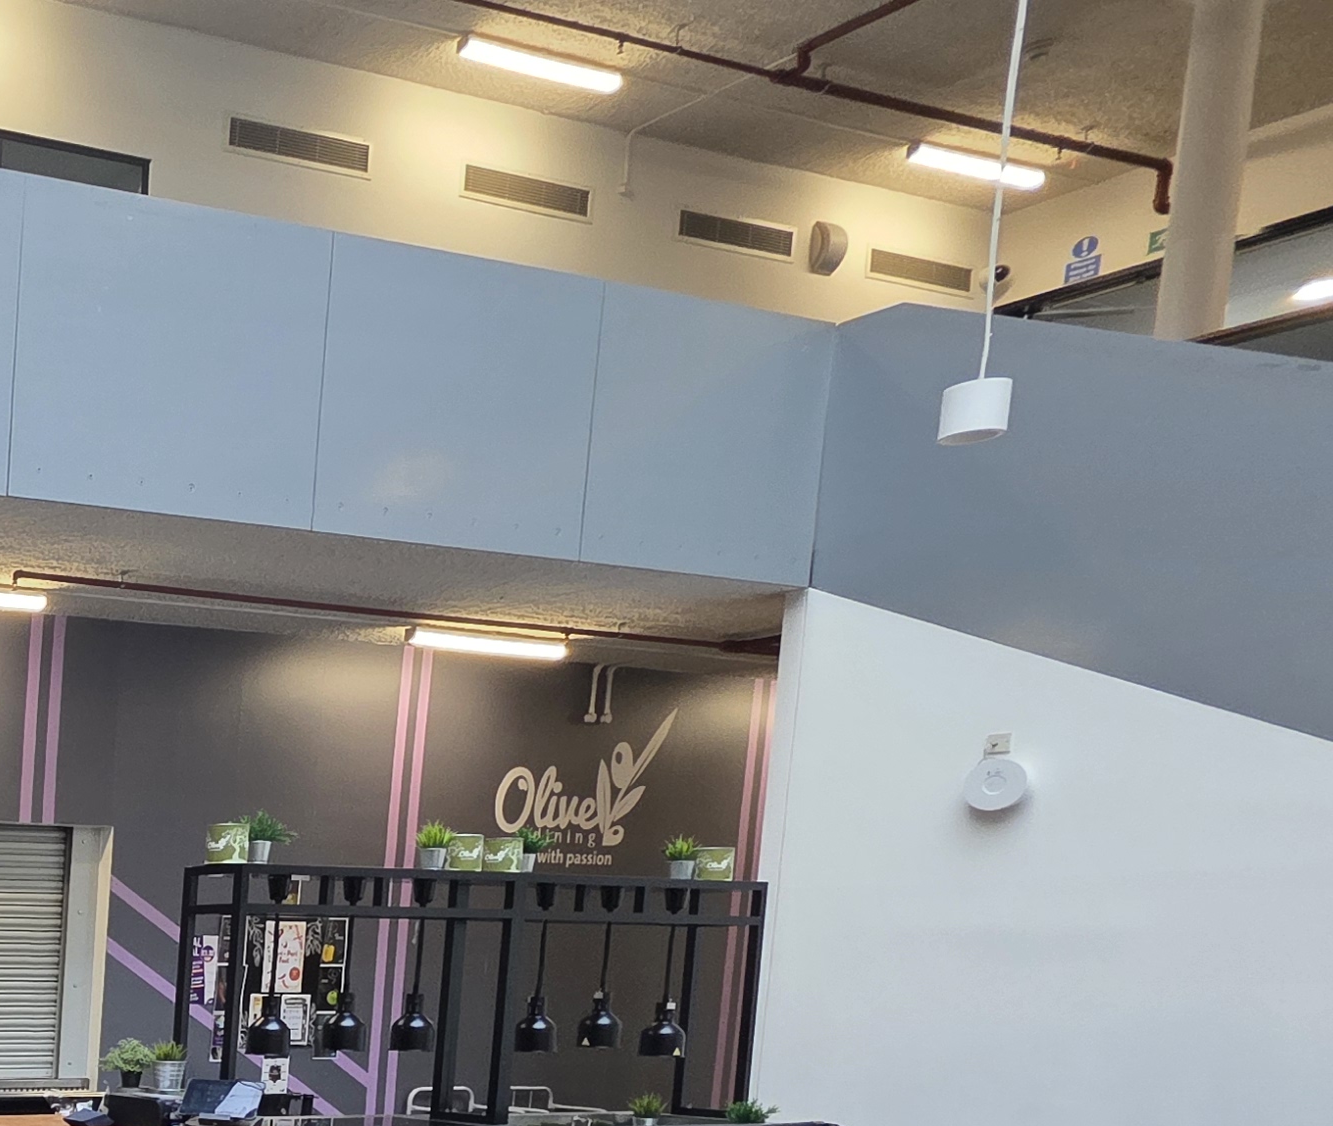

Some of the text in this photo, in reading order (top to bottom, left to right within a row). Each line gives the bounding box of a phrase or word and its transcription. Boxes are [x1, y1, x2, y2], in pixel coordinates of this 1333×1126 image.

[495, 765, 599, 834] Olive
[537, 848, 613, 868] with passion
